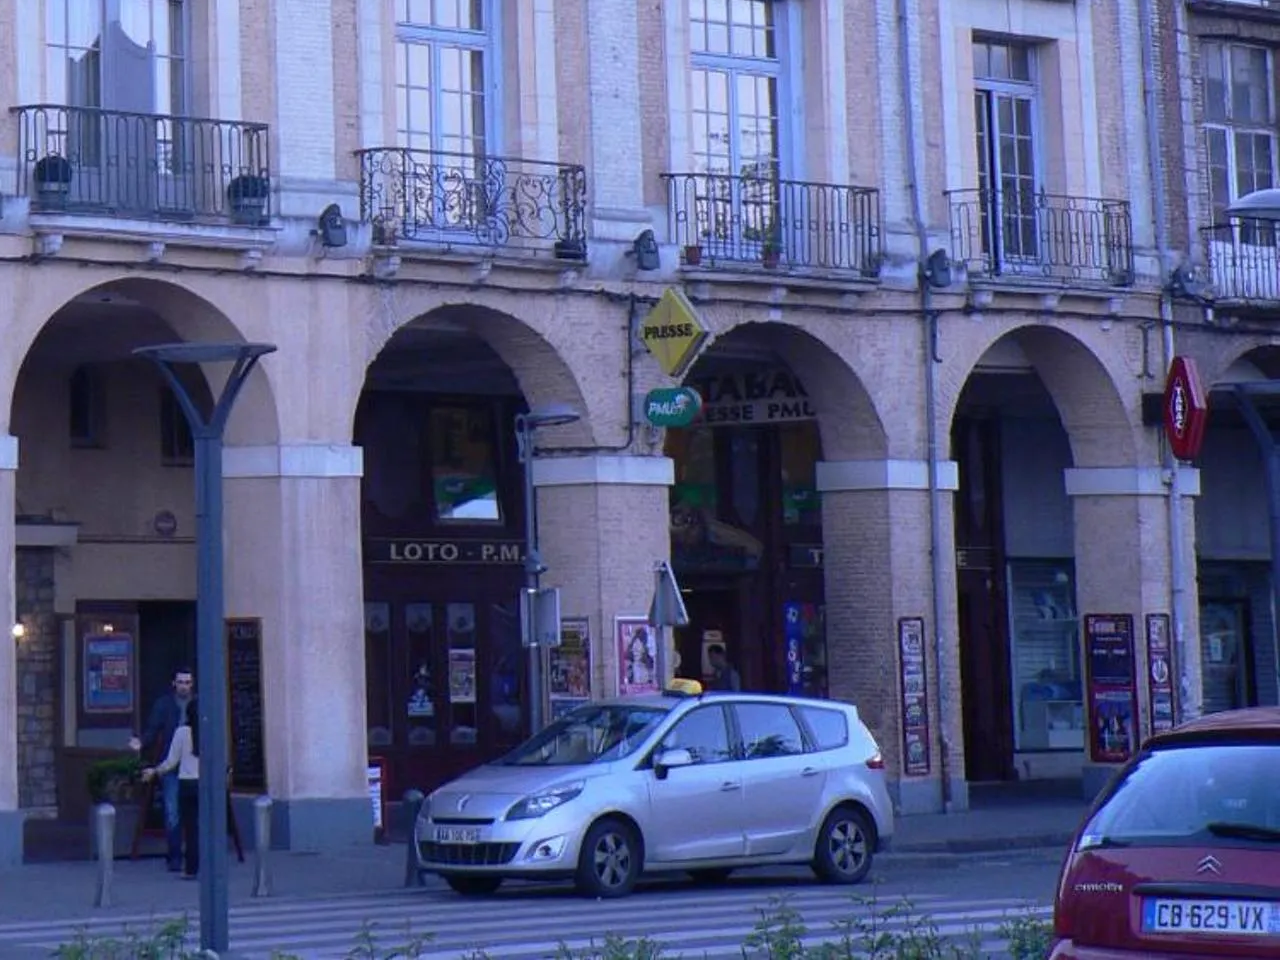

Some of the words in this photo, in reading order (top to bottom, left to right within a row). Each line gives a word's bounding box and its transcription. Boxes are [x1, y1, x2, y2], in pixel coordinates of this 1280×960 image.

[644, 323, 693, 339] PRESSE
[706, 403, 754, 422] ESSE
[389, 543, 458, 560] LOTO
[1157, 904, 1264, 931] CB-629-VX
